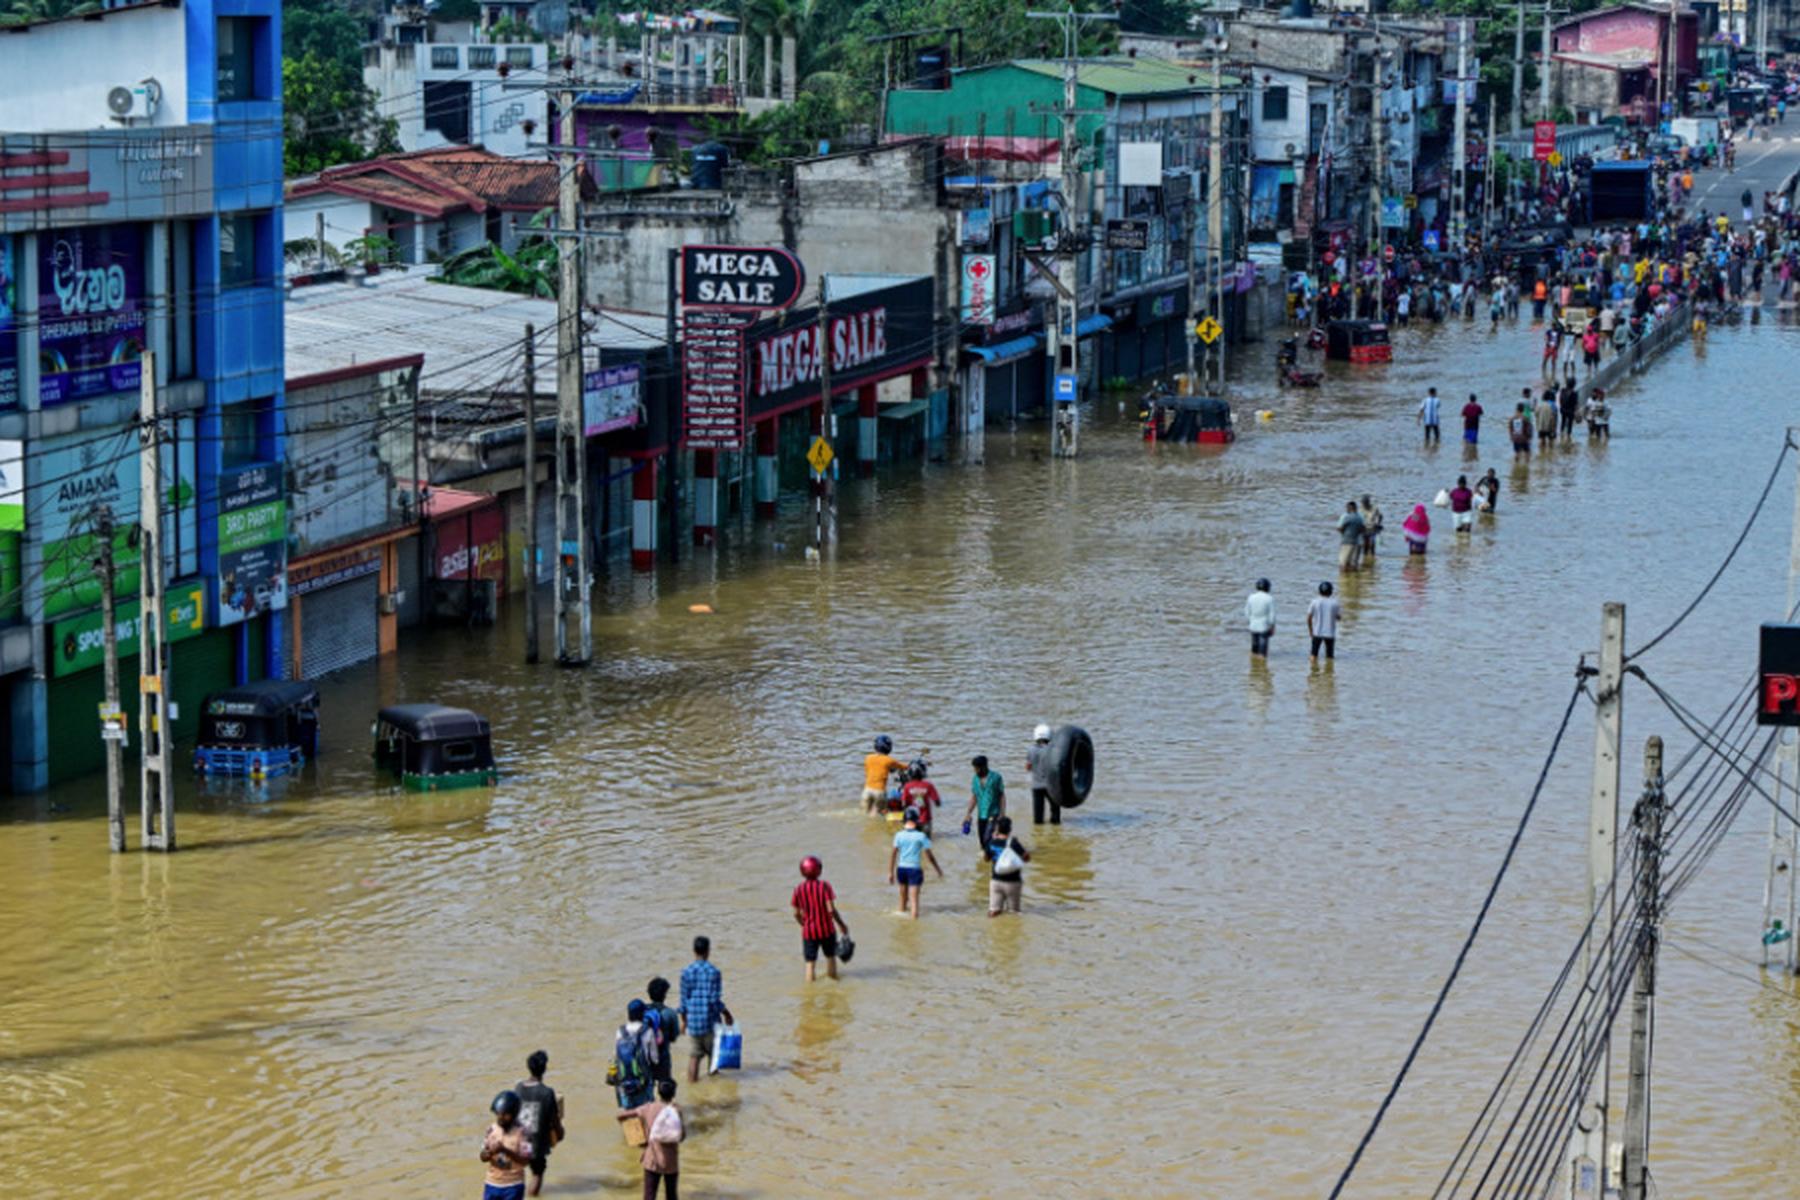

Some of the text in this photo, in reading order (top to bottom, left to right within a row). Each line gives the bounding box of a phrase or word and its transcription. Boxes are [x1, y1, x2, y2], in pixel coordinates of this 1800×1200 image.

[694, 252, 780, 278] MEGA
[697, 281, 775, 305] SALE
[757, 306, 887, 397] MEGA SALE
[57, 473, 120, 503] AMANA
[225, 504, 279, 535] 3RD PARTY
[1763, 673, 1800, 713] P
